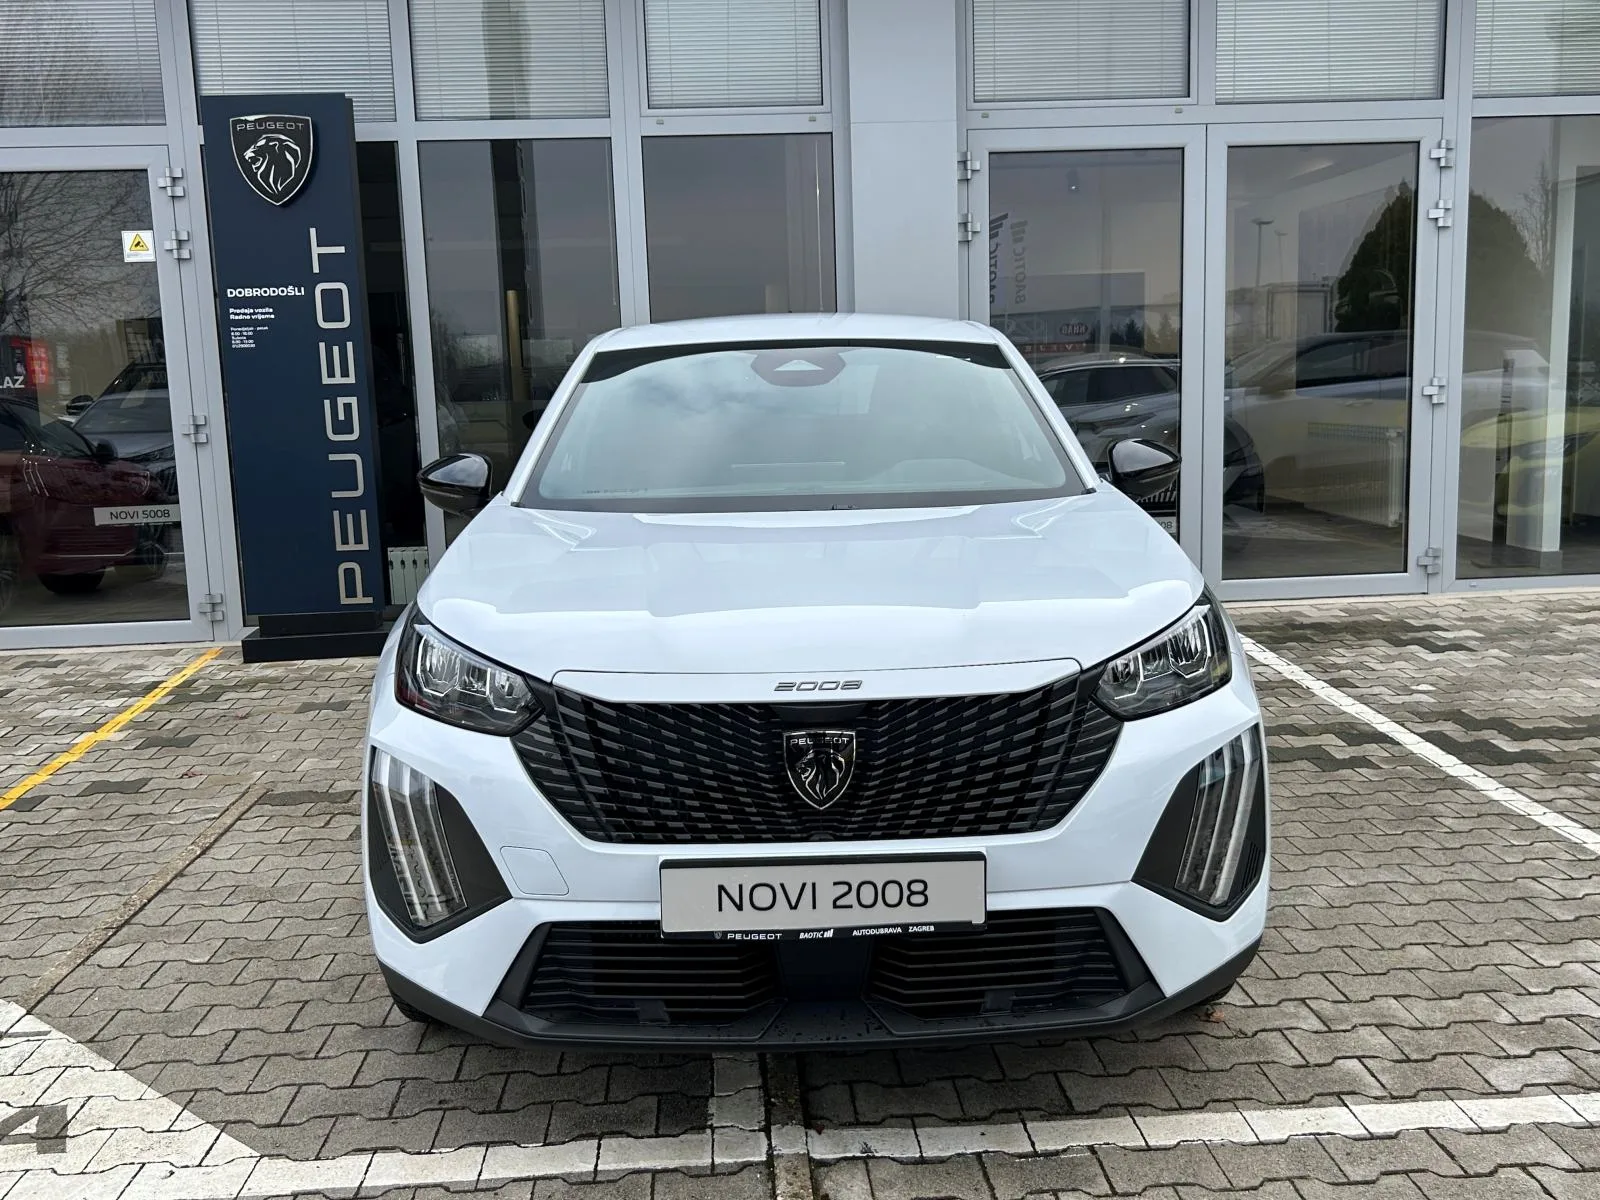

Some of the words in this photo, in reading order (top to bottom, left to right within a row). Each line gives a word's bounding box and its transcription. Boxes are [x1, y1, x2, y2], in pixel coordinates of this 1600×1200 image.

[236, 121, 304, 131] PEUGEOT
[226, 285, 305, 298] DOBRODOŠLI
[0, 376, 25, 388] AZ
[309, 227, 374, 605] PEUGEOT
[110, 510, 139, 520] NOVI
[142, 508, 171, 519] 5008
[773, 679, 863, 692] 2008
[717, 882, 817, 912] NOVI
[832, 879, 929, 909] 2008
[727, 932, 783, 940] PEUGEOT
[852, 926, 902, 936] AUTODUBRAVA
[908, 925, 935, 933] ZAGREB
